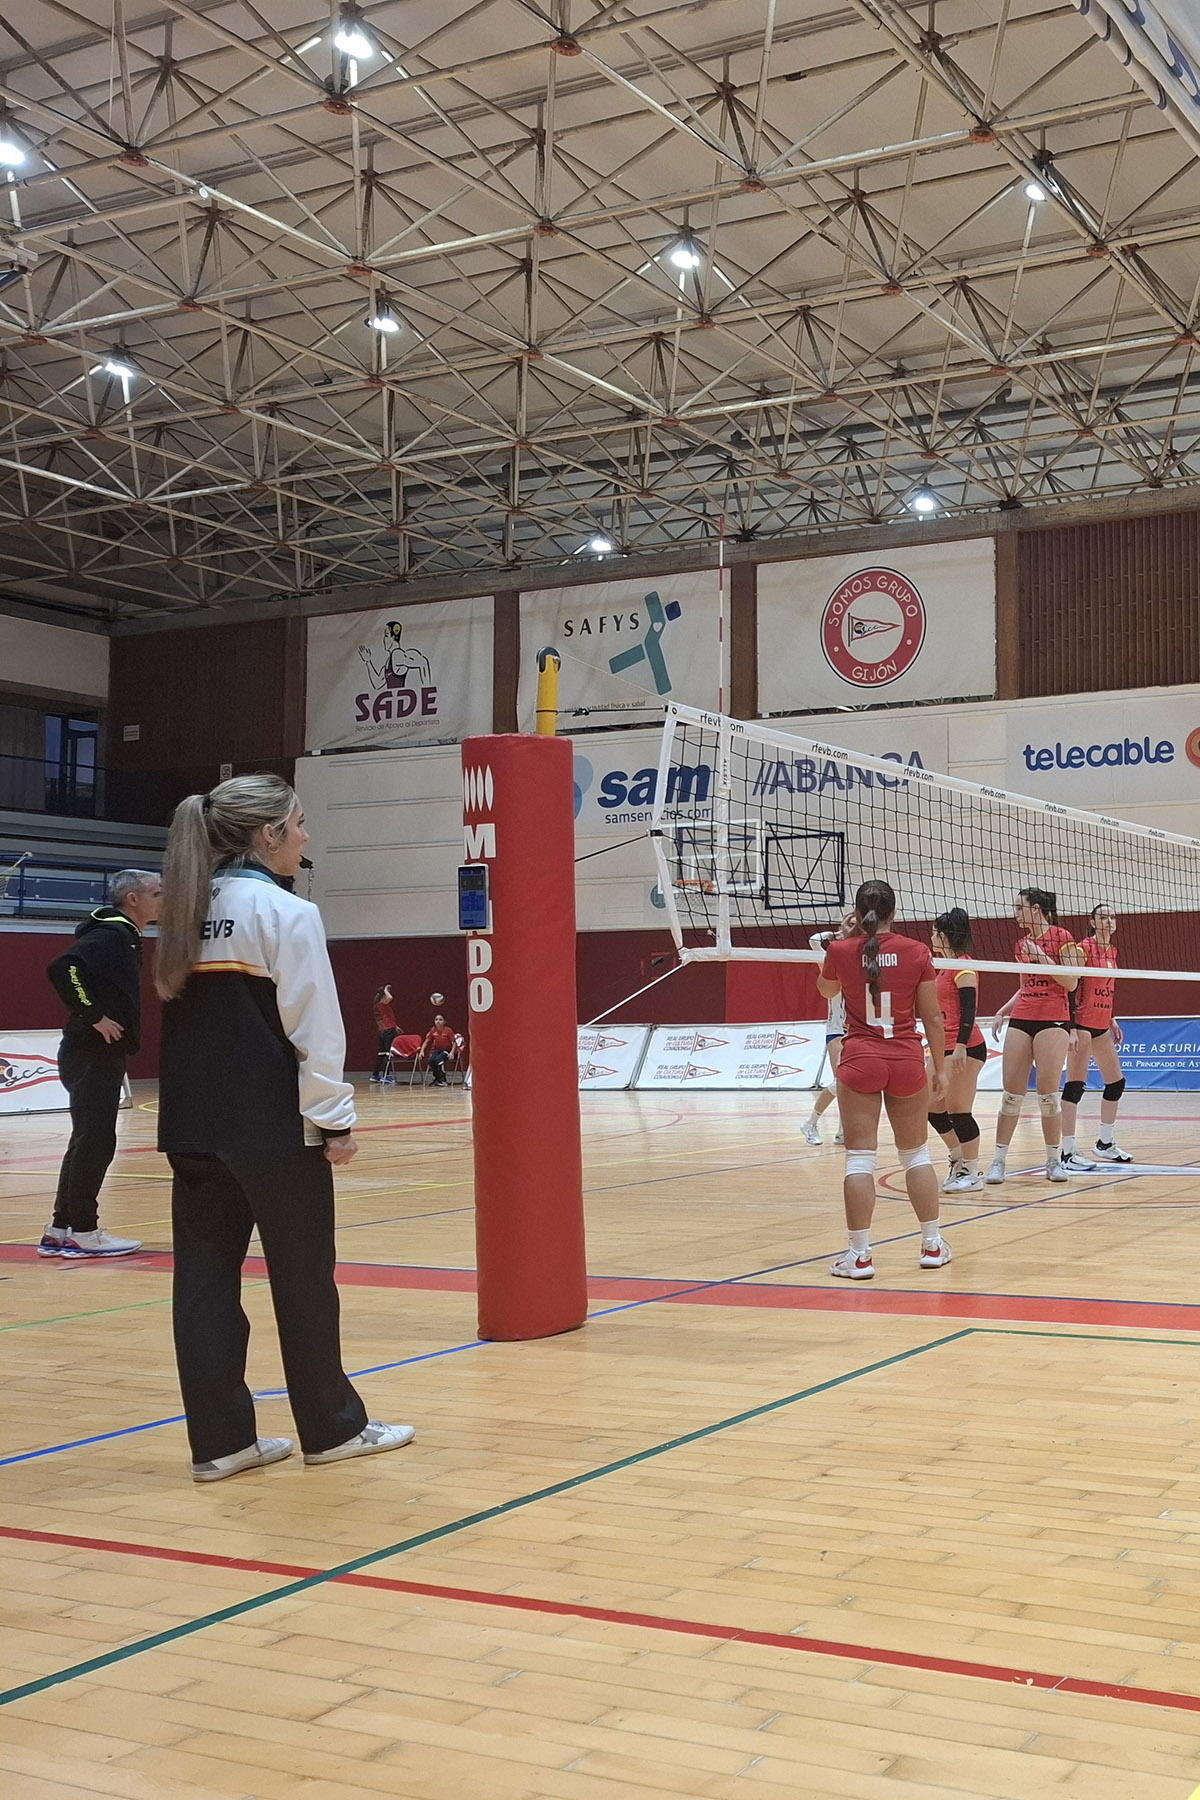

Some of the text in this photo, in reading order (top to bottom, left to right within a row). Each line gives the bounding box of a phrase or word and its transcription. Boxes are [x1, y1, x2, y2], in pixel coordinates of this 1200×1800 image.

[828, 575, 918, 627] SOMOS GRUPO
[564, 612, 640, 637] SAFYS
[852, 659, 898, 681] GIJÓN
[355, 686, 438, 723] SADE
[700, 712, 745, 734] rfevom
[811, 743, 849, 761] rfevb.com
[1023, 736, 1175, 771] telecable
[903, 766, 934, 782] rfevb.com
[597, 764, 711, 808] sam
[980, 786, 1006, 800] rfevb.com
[605, 805, 712, 824] samservcios.com
[464, 823, 496, 1012] MDO
[200, 919, 235, 940] EVB
[862, 953, 898, 968] AHOA
[866, 983, 895, 1039] 4
[1114, 1043, 1146, 1053] ORTE
[1136, 1060, 1175, 1068] PRINCIPADO
